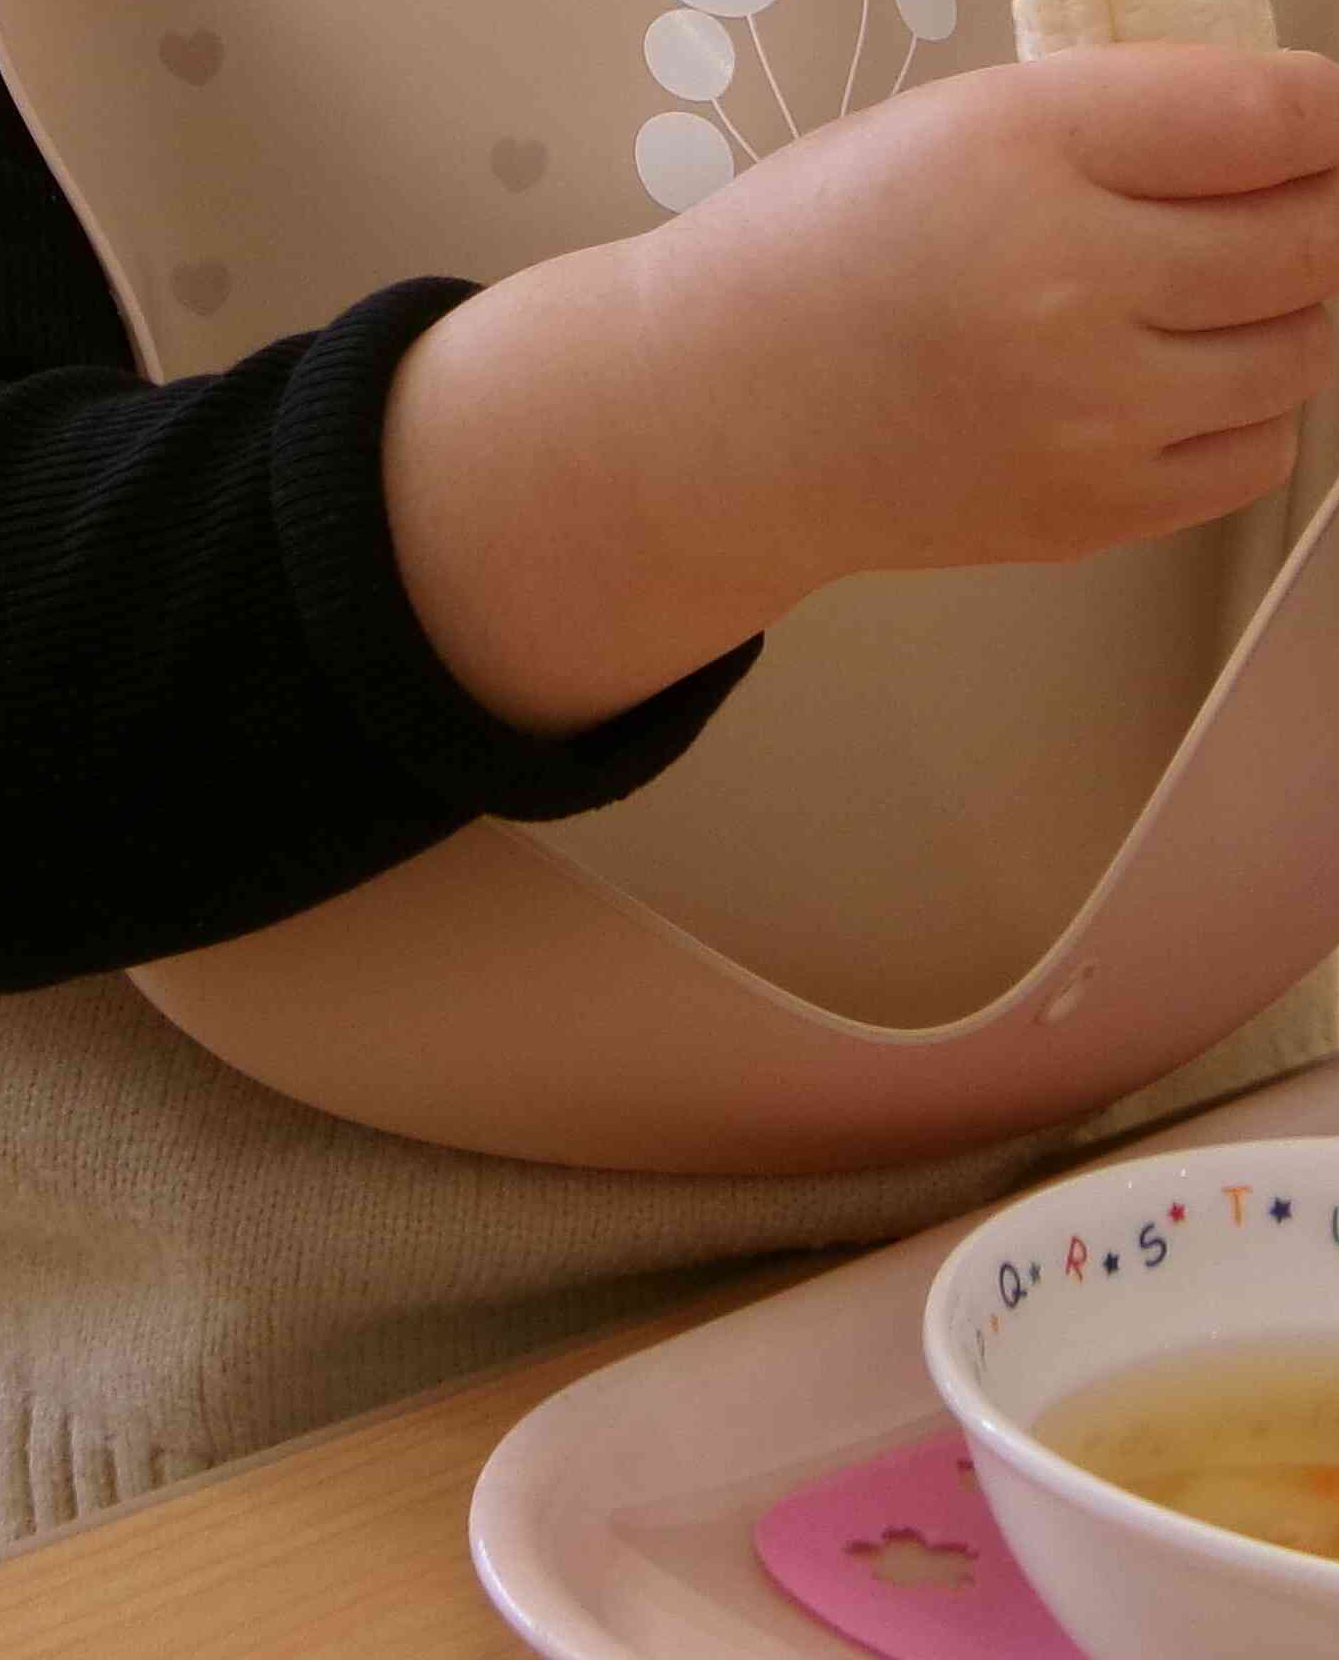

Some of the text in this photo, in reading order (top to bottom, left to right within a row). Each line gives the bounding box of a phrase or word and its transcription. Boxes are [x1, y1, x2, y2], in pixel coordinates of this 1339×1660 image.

[999, 1262, 1028, 1309] Q
[1065, 1235, 1088, 1283] R
[1139, 1222, 1167, 1268] S
[1221, 1186, 1253, 1227] T
